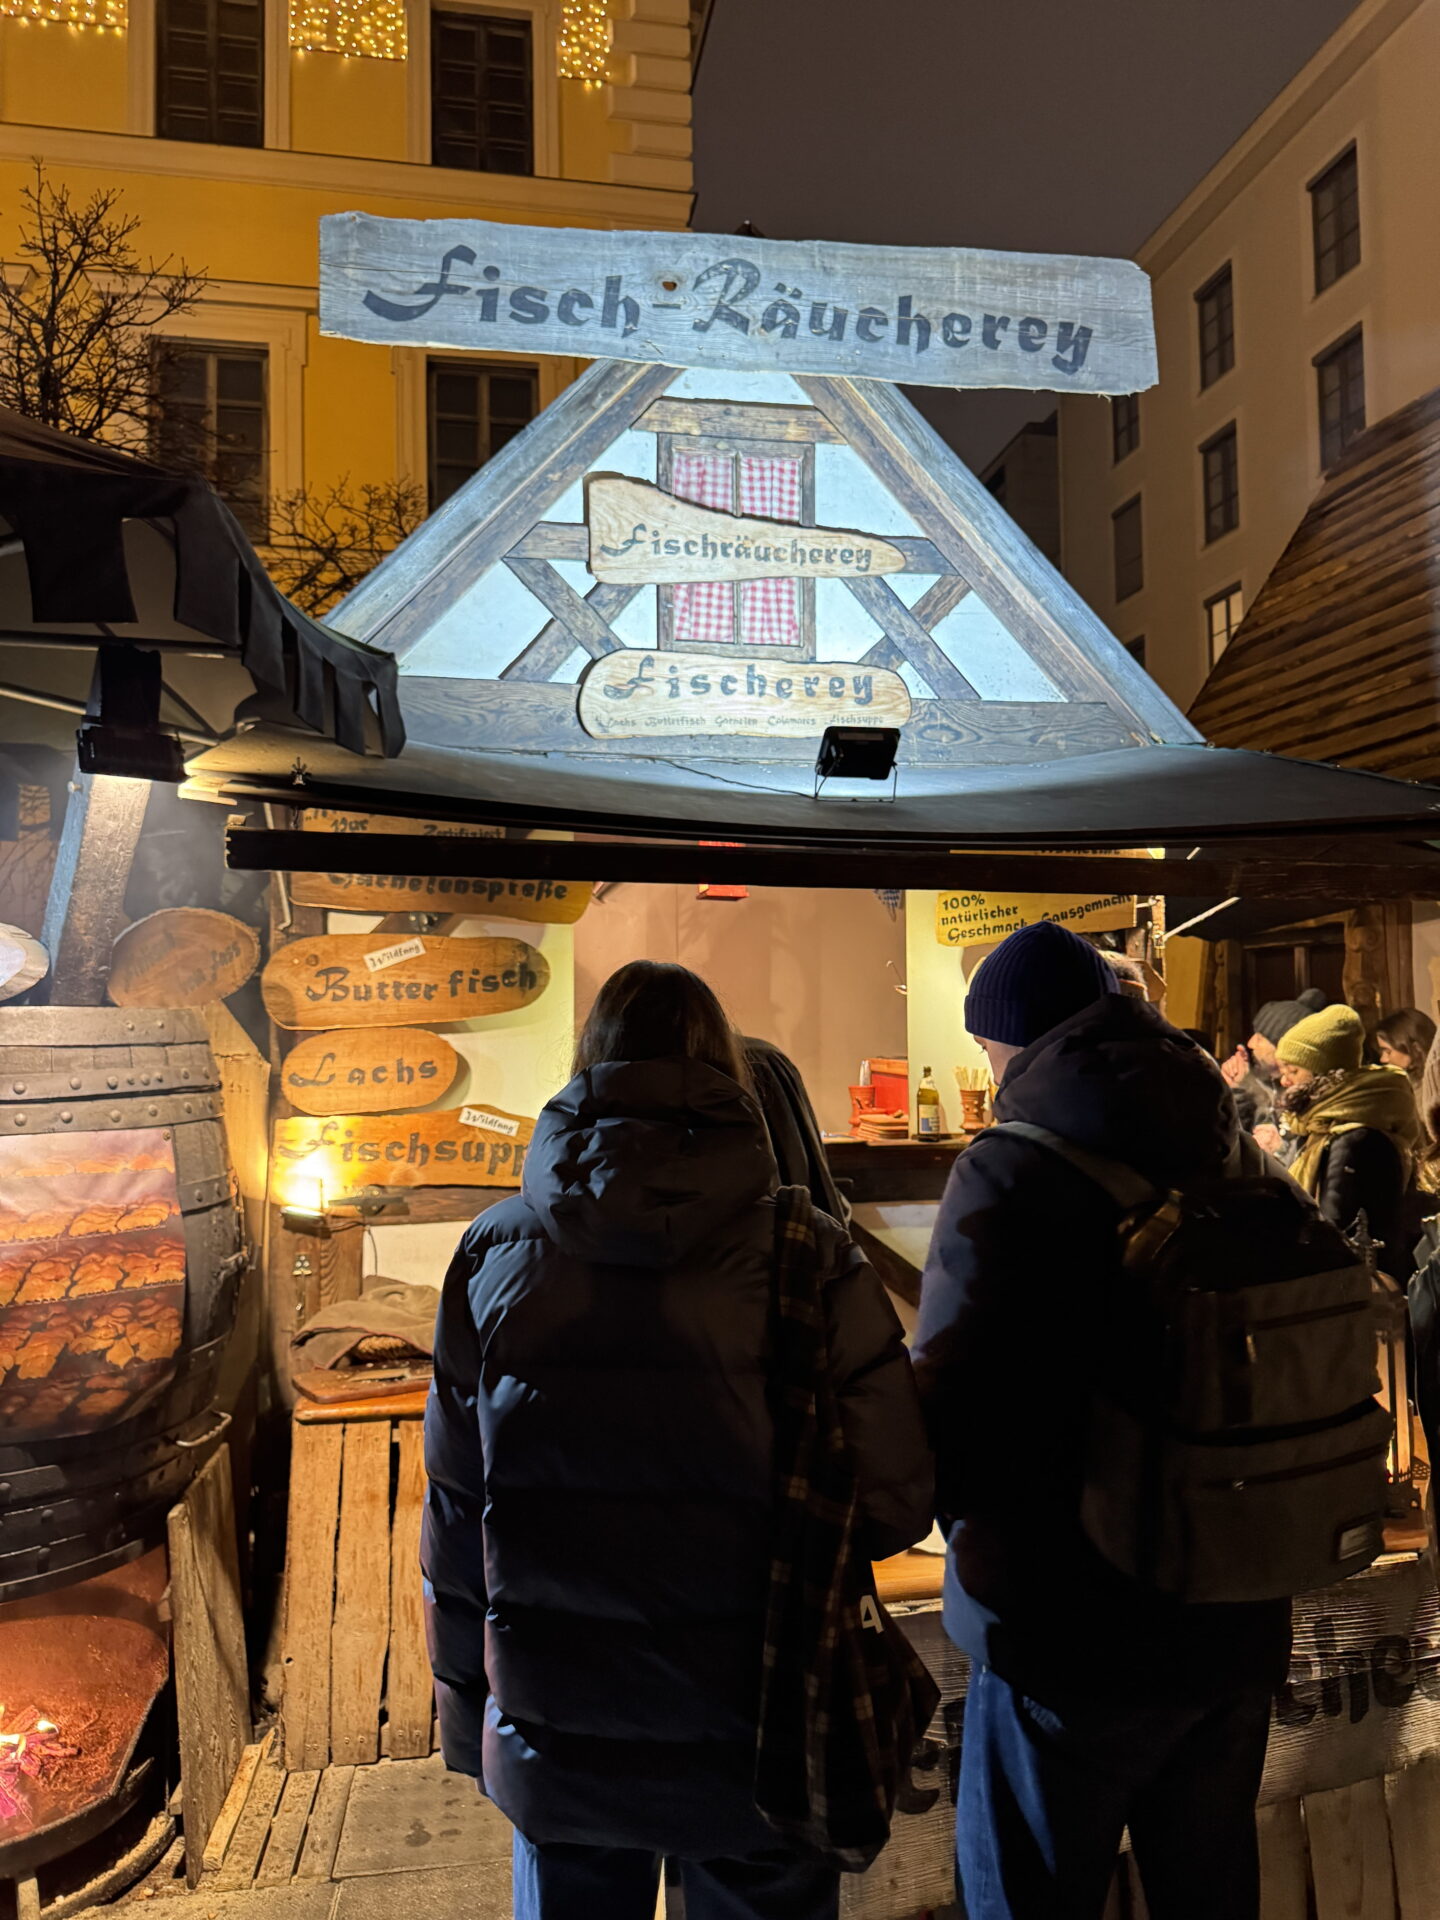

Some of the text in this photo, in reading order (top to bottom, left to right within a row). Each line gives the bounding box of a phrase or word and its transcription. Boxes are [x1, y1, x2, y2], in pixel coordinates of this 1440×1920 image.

[600, 523, 872, 572] Fischräucherey
[603, 655, 873, 705] Fischerey
[941, 905, 1019, 926] natürlicher
[942, 894, 986, 911] 100%
[288, 1053, 438, 1089] Lachs
[278, 1121, 529, 1178] Fischsupp
